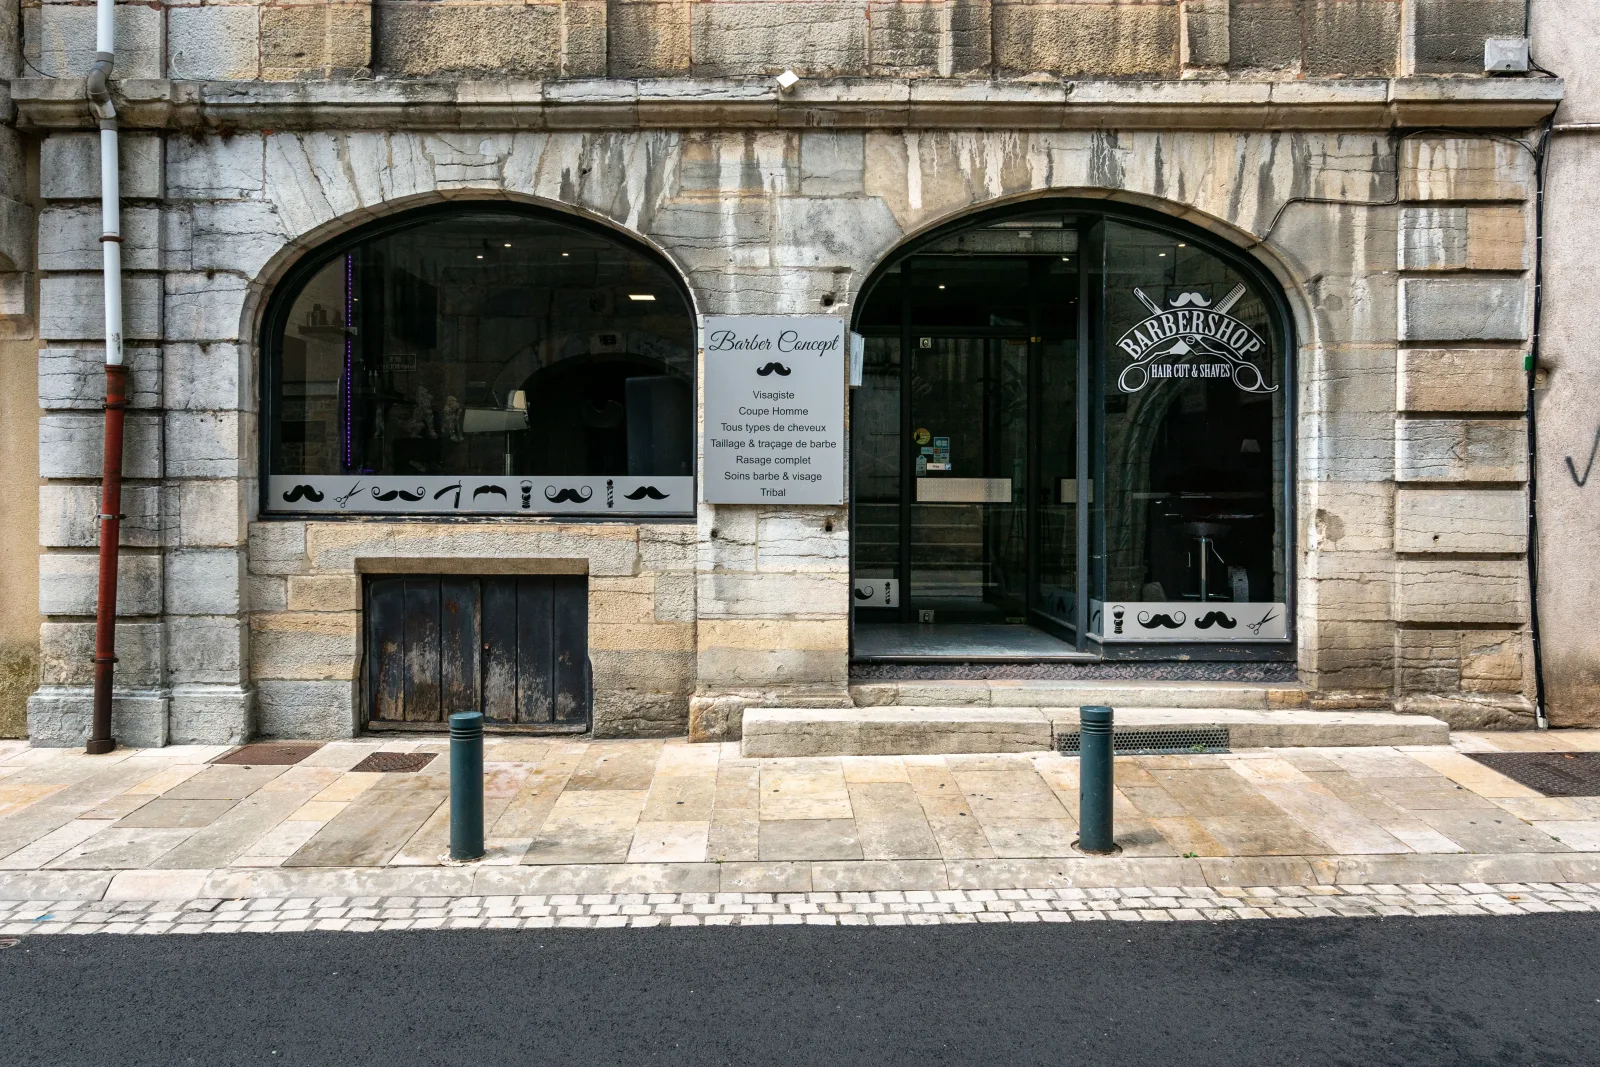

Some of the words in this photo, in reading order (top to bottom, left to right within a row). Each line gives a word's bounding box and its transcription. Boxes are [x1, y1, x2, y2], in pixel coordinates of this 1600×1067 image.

[1119, 310, 1261, 360] BARBERSHOP
[708, 330, 772, 352] Barber
[777, 330, 840, 357] Concept
[1151, 363, 1172, 378] HAIR
[1173, 363, 1190, 378] CUT
[1191, 363, 1198, 378] &
[1199, 363, 1231, 378] SHAVES
[752, 390, 795, 401] Visagiste
[738, 406, 770, 417] Coupe
[772, 406, 809, 416] Homme
[721, 422, 743, 432] Tous
[745, 423, 771, 434] types
[773, 422, 785, 432] de
[787, 423, 827, 432] cheveux
[710, 438, 746, 449] Taillage
[748, 438, 756, 448] &
[758, 439, 793, 450] traçage
[795, 439, 808, 449] de
[809, 439, 837, 449] barbe
[736, 455, 772, 466] Rasage
[774, 455, 812, 466] complet
[724, 471, 751, 481] Soins
[753, 471, 780, 481] barbe
[782, 471, 790, 481] &
[792, 471, 823, 482] visage
[760, 487, 786, 497] Tribal
